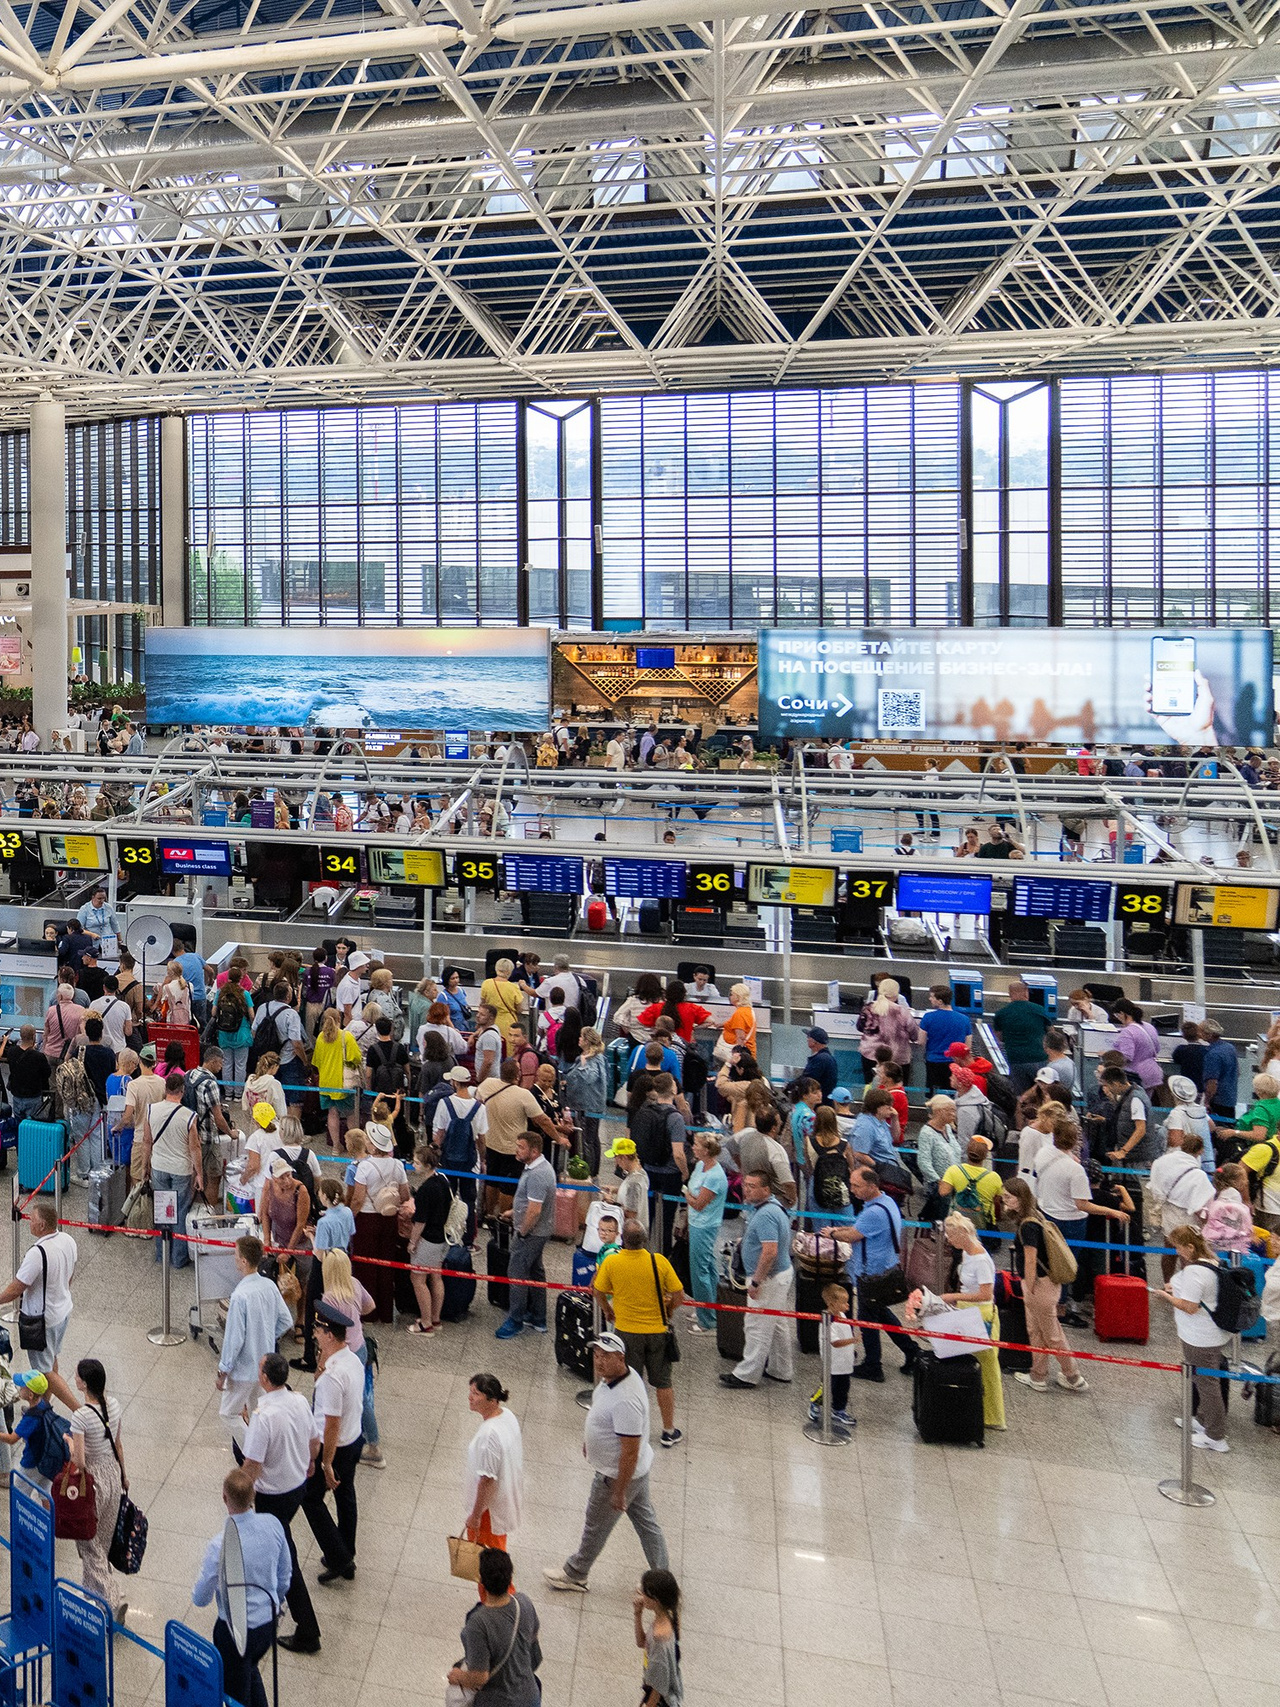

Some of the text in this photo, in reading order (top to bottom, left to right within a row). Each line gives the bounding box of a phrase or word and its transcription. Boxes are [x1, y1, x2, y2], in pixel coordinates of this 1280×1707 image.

[778, 638, 1003, 655] ПРИОБРЕТАЙТЕ КАРТУ
[778, 660, 806, 674] НА
[811, 660, 935, 676] ПОСЕЩЕНИЕ
[778, 696, 829, 710] Сочи
[123, 846, 152, 864] 33
[326, 854, 356, 874] 34
[462, 862, 494, 880] 35
[695, 872, 730, 891] 36
[852, 880, 888, 898] 37
[1122, 894, 1163, 914] 38
[58, 1592, 102, 1626] Проверьте свою
[62, 1607, 82, 1625] ручную
